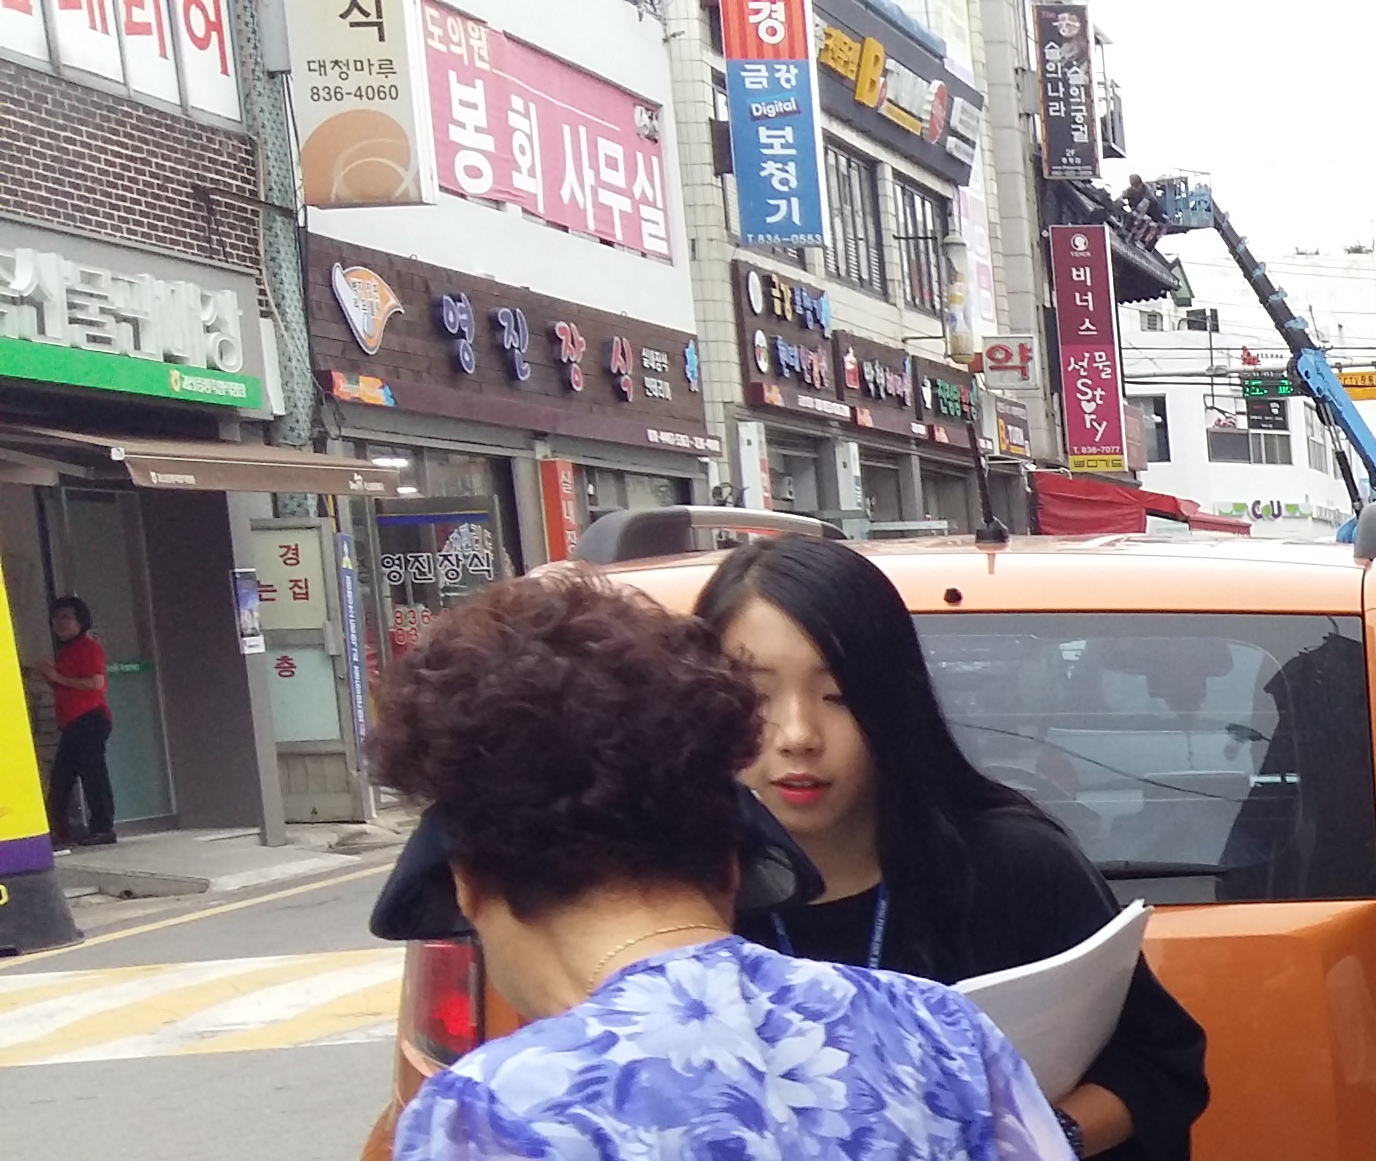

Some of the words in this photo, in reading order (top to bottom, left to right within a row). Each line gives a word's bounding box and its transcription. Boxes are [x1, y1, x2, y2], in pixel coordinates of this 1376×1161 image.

[424, 5, 491, 71] 도의원
[306, 58, 398, 81] 대청마루
[740, 64, 799, 90] 금강
[310, 84, 399, 102] 836-4060
[750, 97, 797, 118] Digital
[560, 124, 670, 254] 사무실
[758, 126, 801, 226] 보청기
[1071, 266, 1098, 336] 비너스
[442, 292, 634, 402] 영진장식
[986, 342, 1034, 381] 약
[1251, 499, 1282, 520] CU
[278, 543, 301, 567] 경
[380, 551, 494, 586] 영진장식
[288, 577, 310, 601] 집
[274, 655, 297, 678] 층
